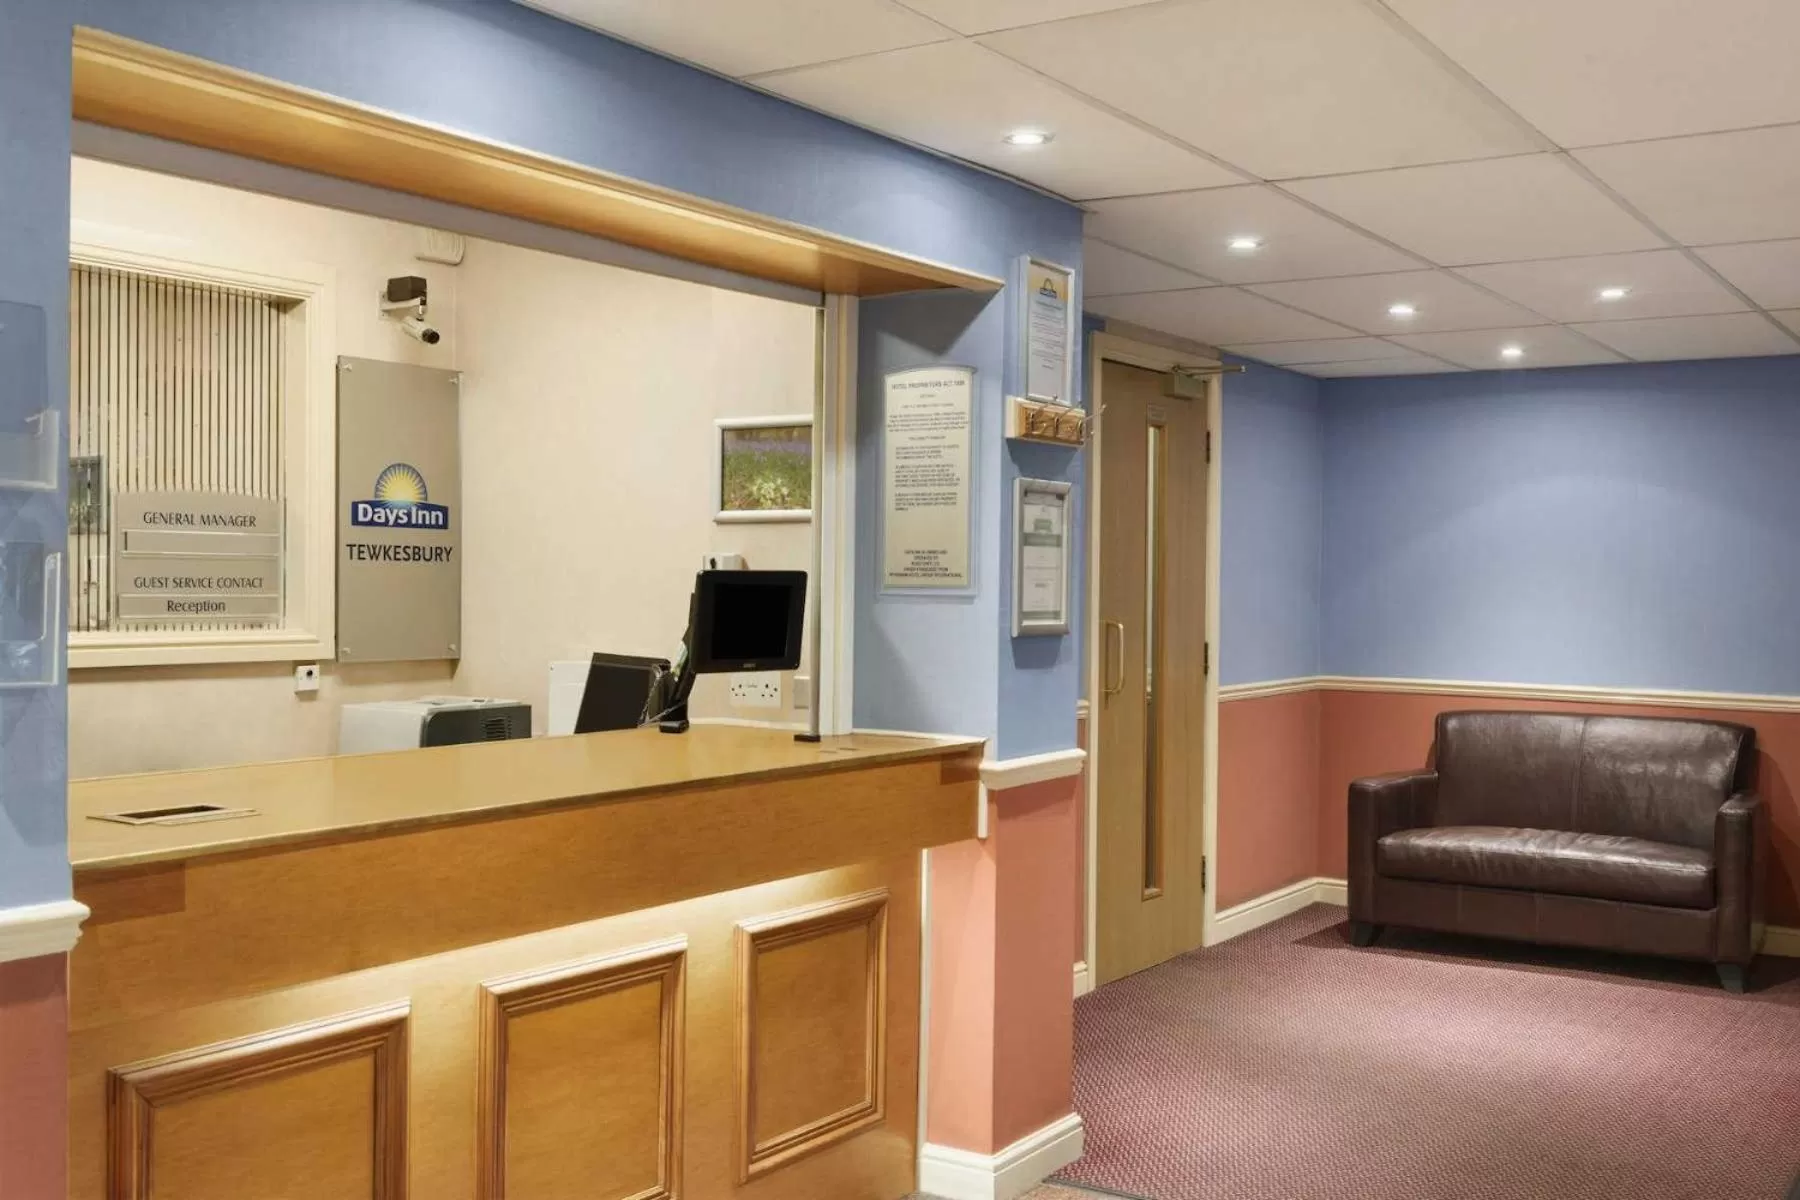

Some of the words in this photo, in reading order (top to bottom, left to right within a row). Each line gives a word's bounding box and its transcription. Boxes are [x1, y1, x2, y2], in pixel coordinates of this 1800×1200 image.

[143, 511, 196, 525] GENERAL
[200, 513, 257, 527] MANAGER
[357, 503, 409, 526] Days
[411, 506, 444, 525] Inn
[346, 543, 453, 562] TEWKESBURY
[134, 576, 169, 588] GUEST
[172, 576, 213, 588] SERVICE
[216, 577, 264, 588] CONTACT
[167, 600, 226, 614] Reception
